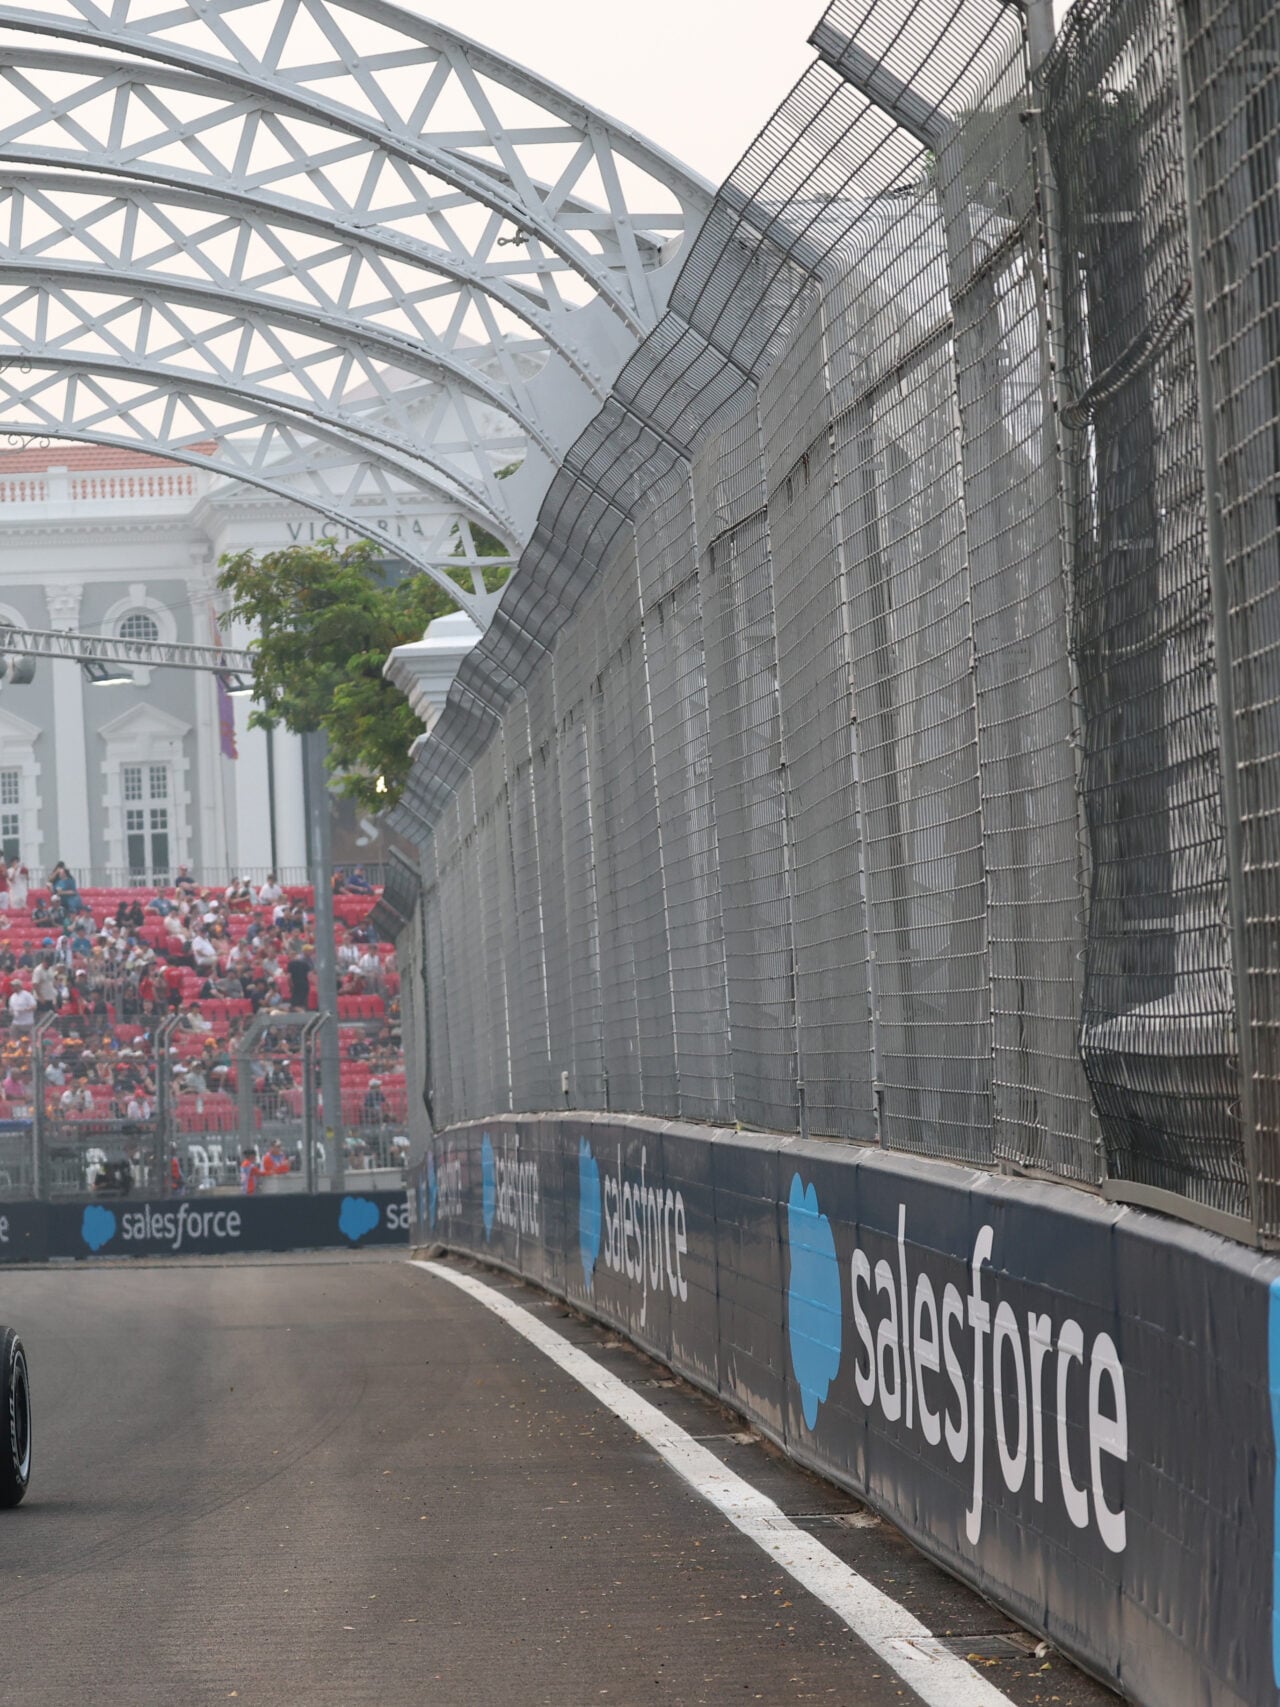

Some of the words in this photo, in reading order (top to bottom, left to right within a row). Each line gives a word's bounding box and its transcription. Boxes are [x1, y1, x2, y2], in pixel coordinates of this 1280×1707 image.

[287, 519, 424, 541] VICTRIA
[122, 1203, 241, 1248] salesforce
[604, 1143, 688, 1327] salesforce
[851, 1203, 1128, 1553] salesforce
